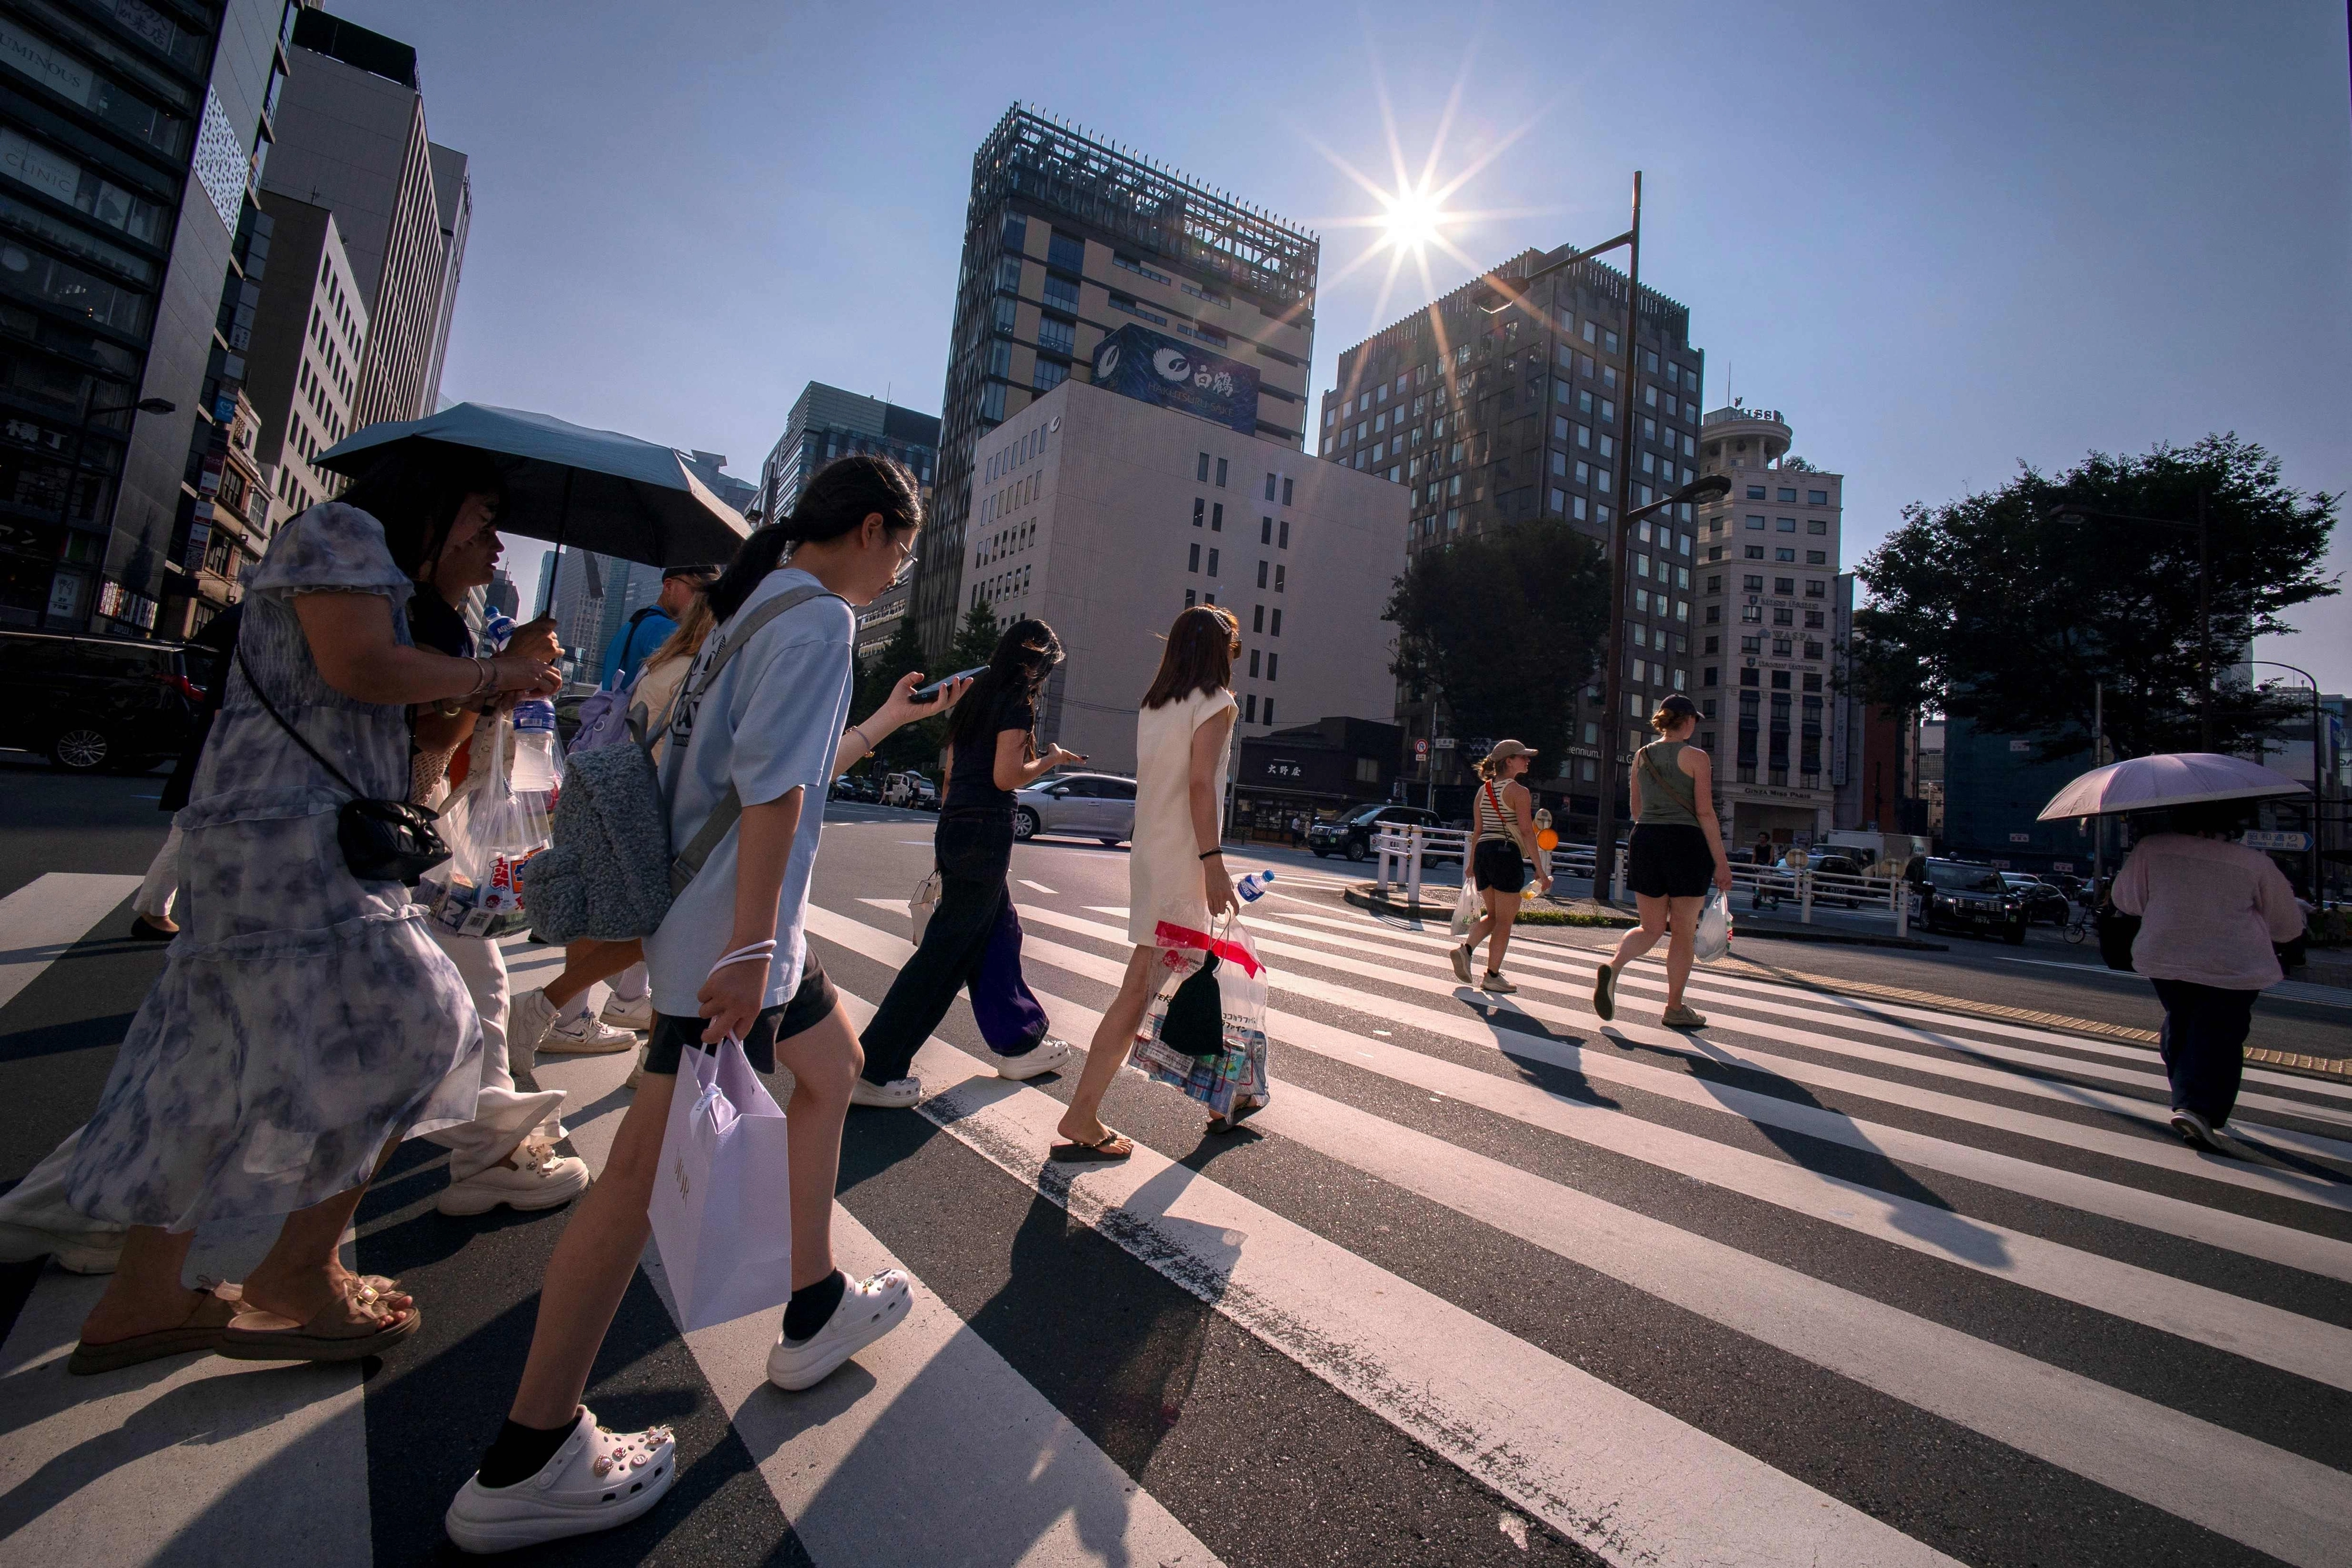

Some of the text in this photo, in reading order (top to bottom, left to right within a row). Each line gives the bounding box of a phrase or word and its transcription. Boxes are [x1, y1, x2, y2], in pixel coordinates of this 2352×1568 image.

[5, 153, 72, 192] CLINIC
[1641, 288, 1665, 305] Garden
[1667, 300, 1685, 316] Hotel
[1194, 365, 1233, 397] 白鶴
[1148, 382, 1234, 417] HAKUTSURU SAKE
[1761, 598, 1819, 610] MISS PARIS
[497, 621, 519, 634] AQUAR
[1567, 746, 1599, 758] lennium
[1267, 764, 1301, 777] 大野屋
[2247, 832, 2298, 842] 昭和通り
[1221, 1019, 1247, 1033] ラファイン
[696, 1091, 713, 1112] DIOR
